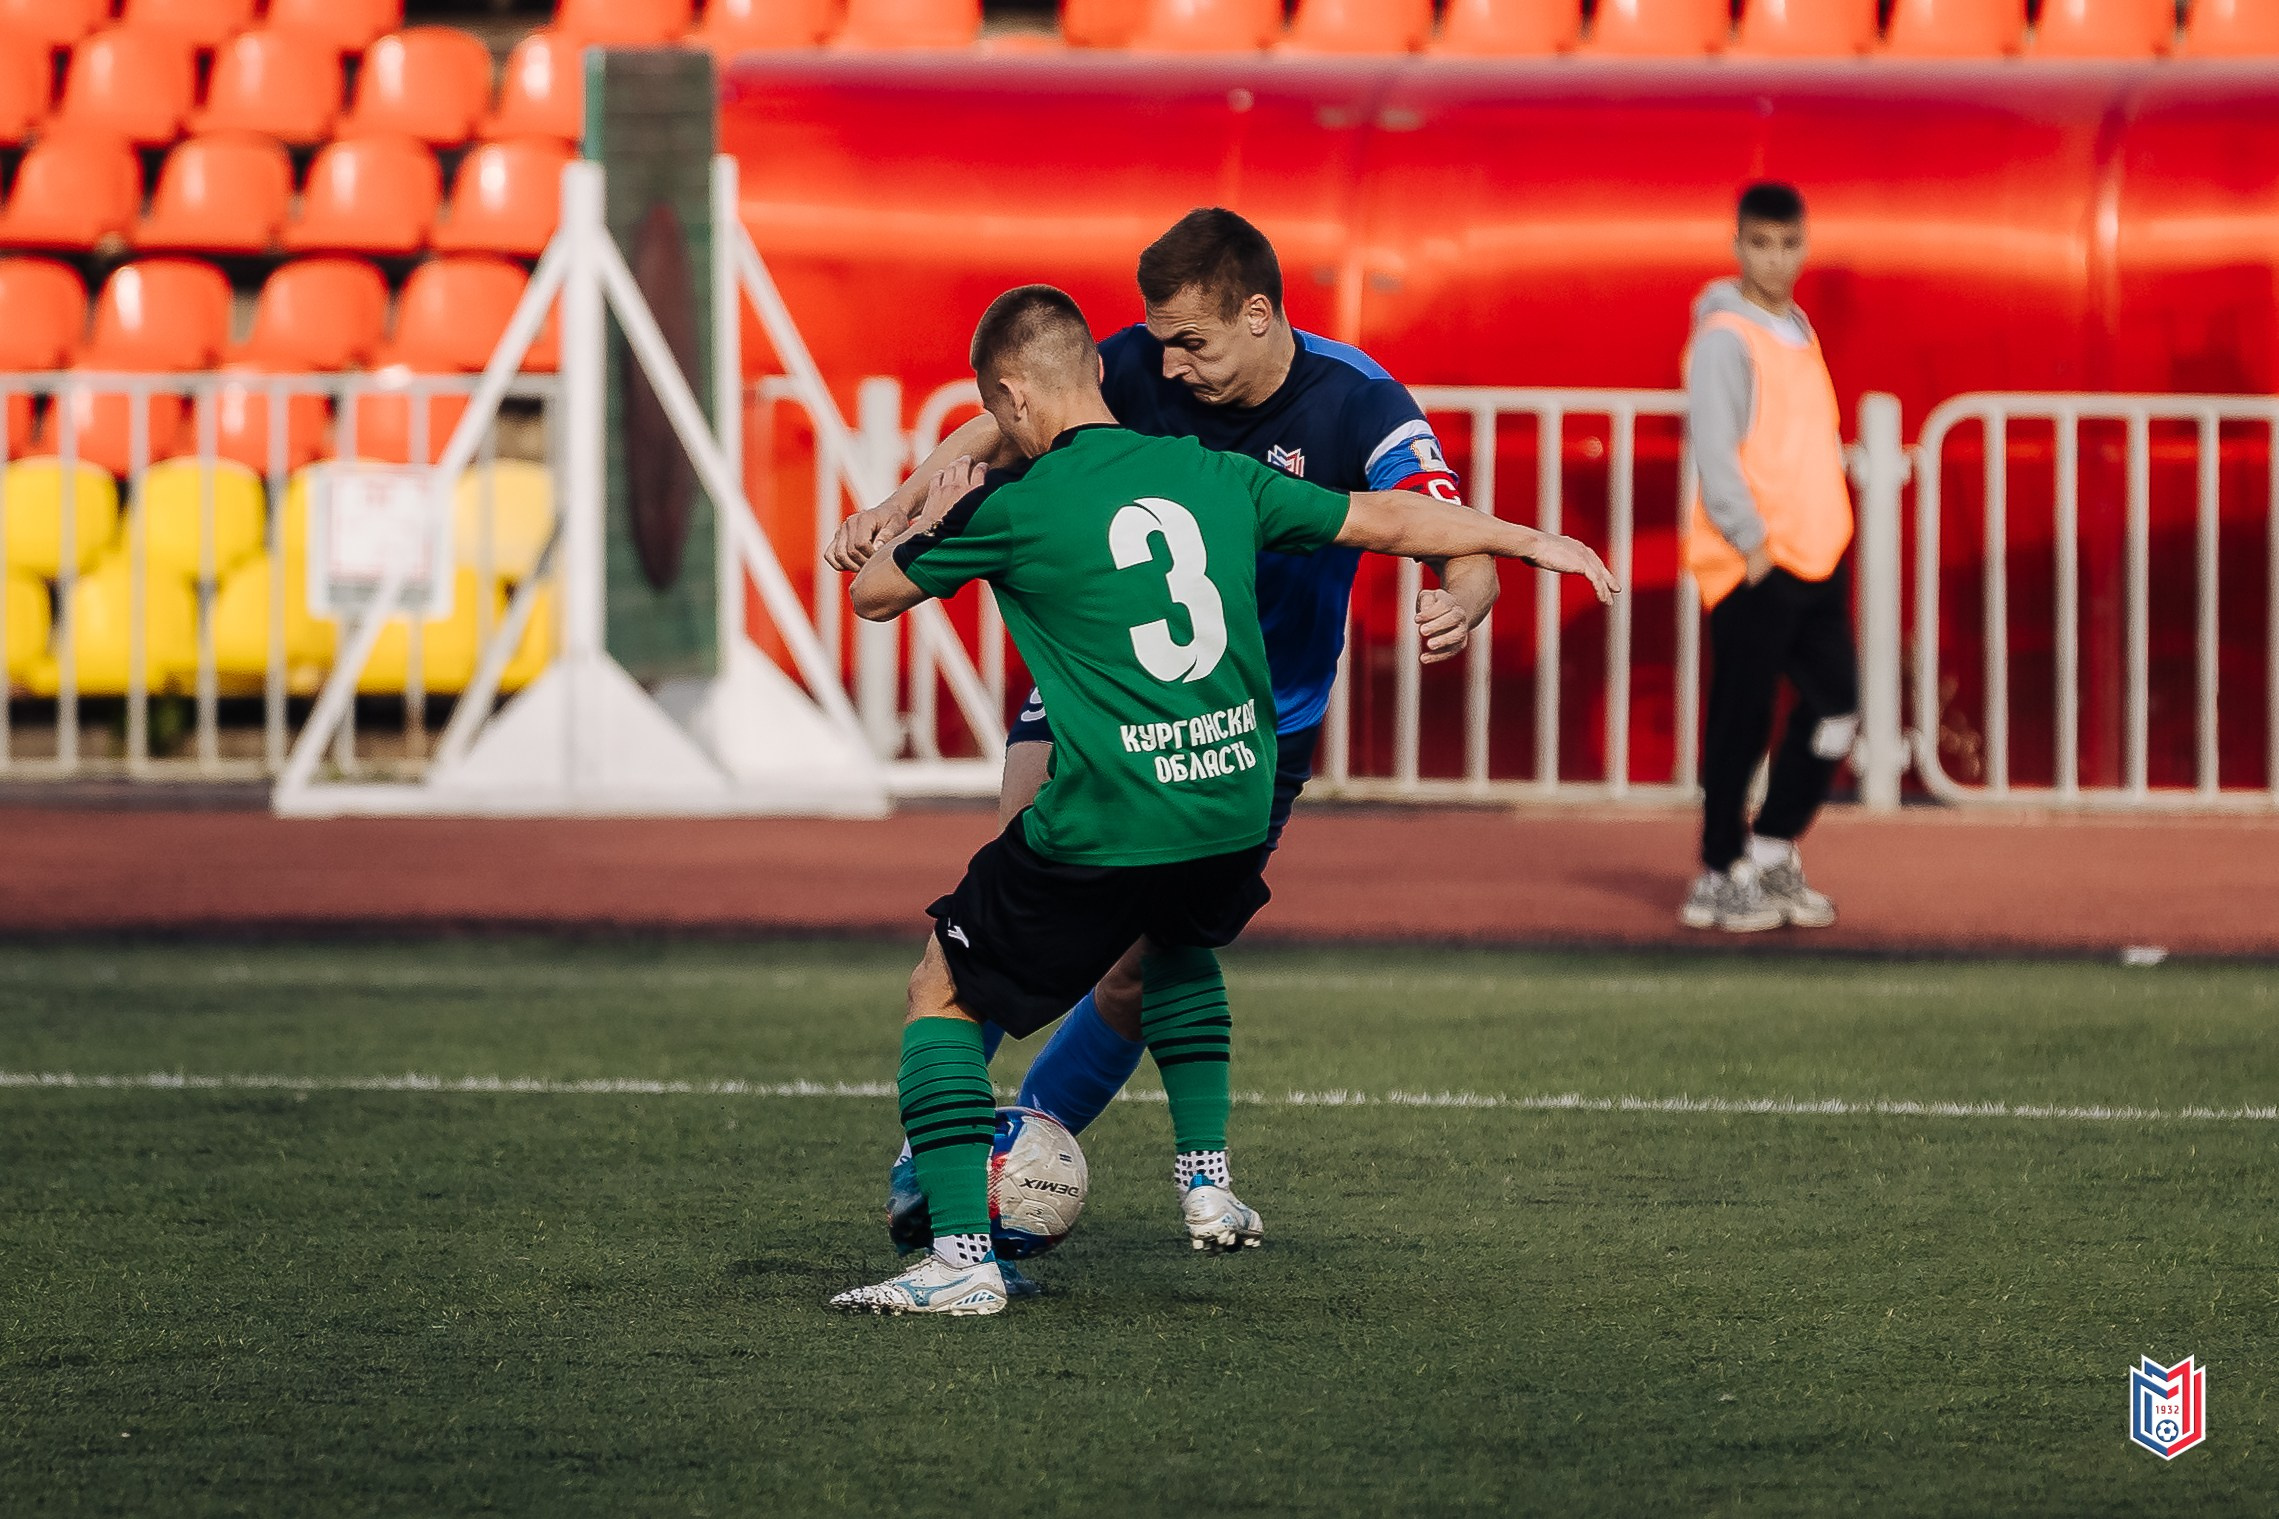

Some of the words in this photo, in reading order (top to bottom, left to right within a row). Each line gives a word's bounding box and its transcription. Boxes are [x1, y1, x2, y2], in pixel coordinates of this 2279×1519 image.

[1108, 497, 1227, 683] 3
[1154, 741, 1256, 783] ОБЛАСТЬ
[1019, 1178, 1079, 1197] DEMIX
